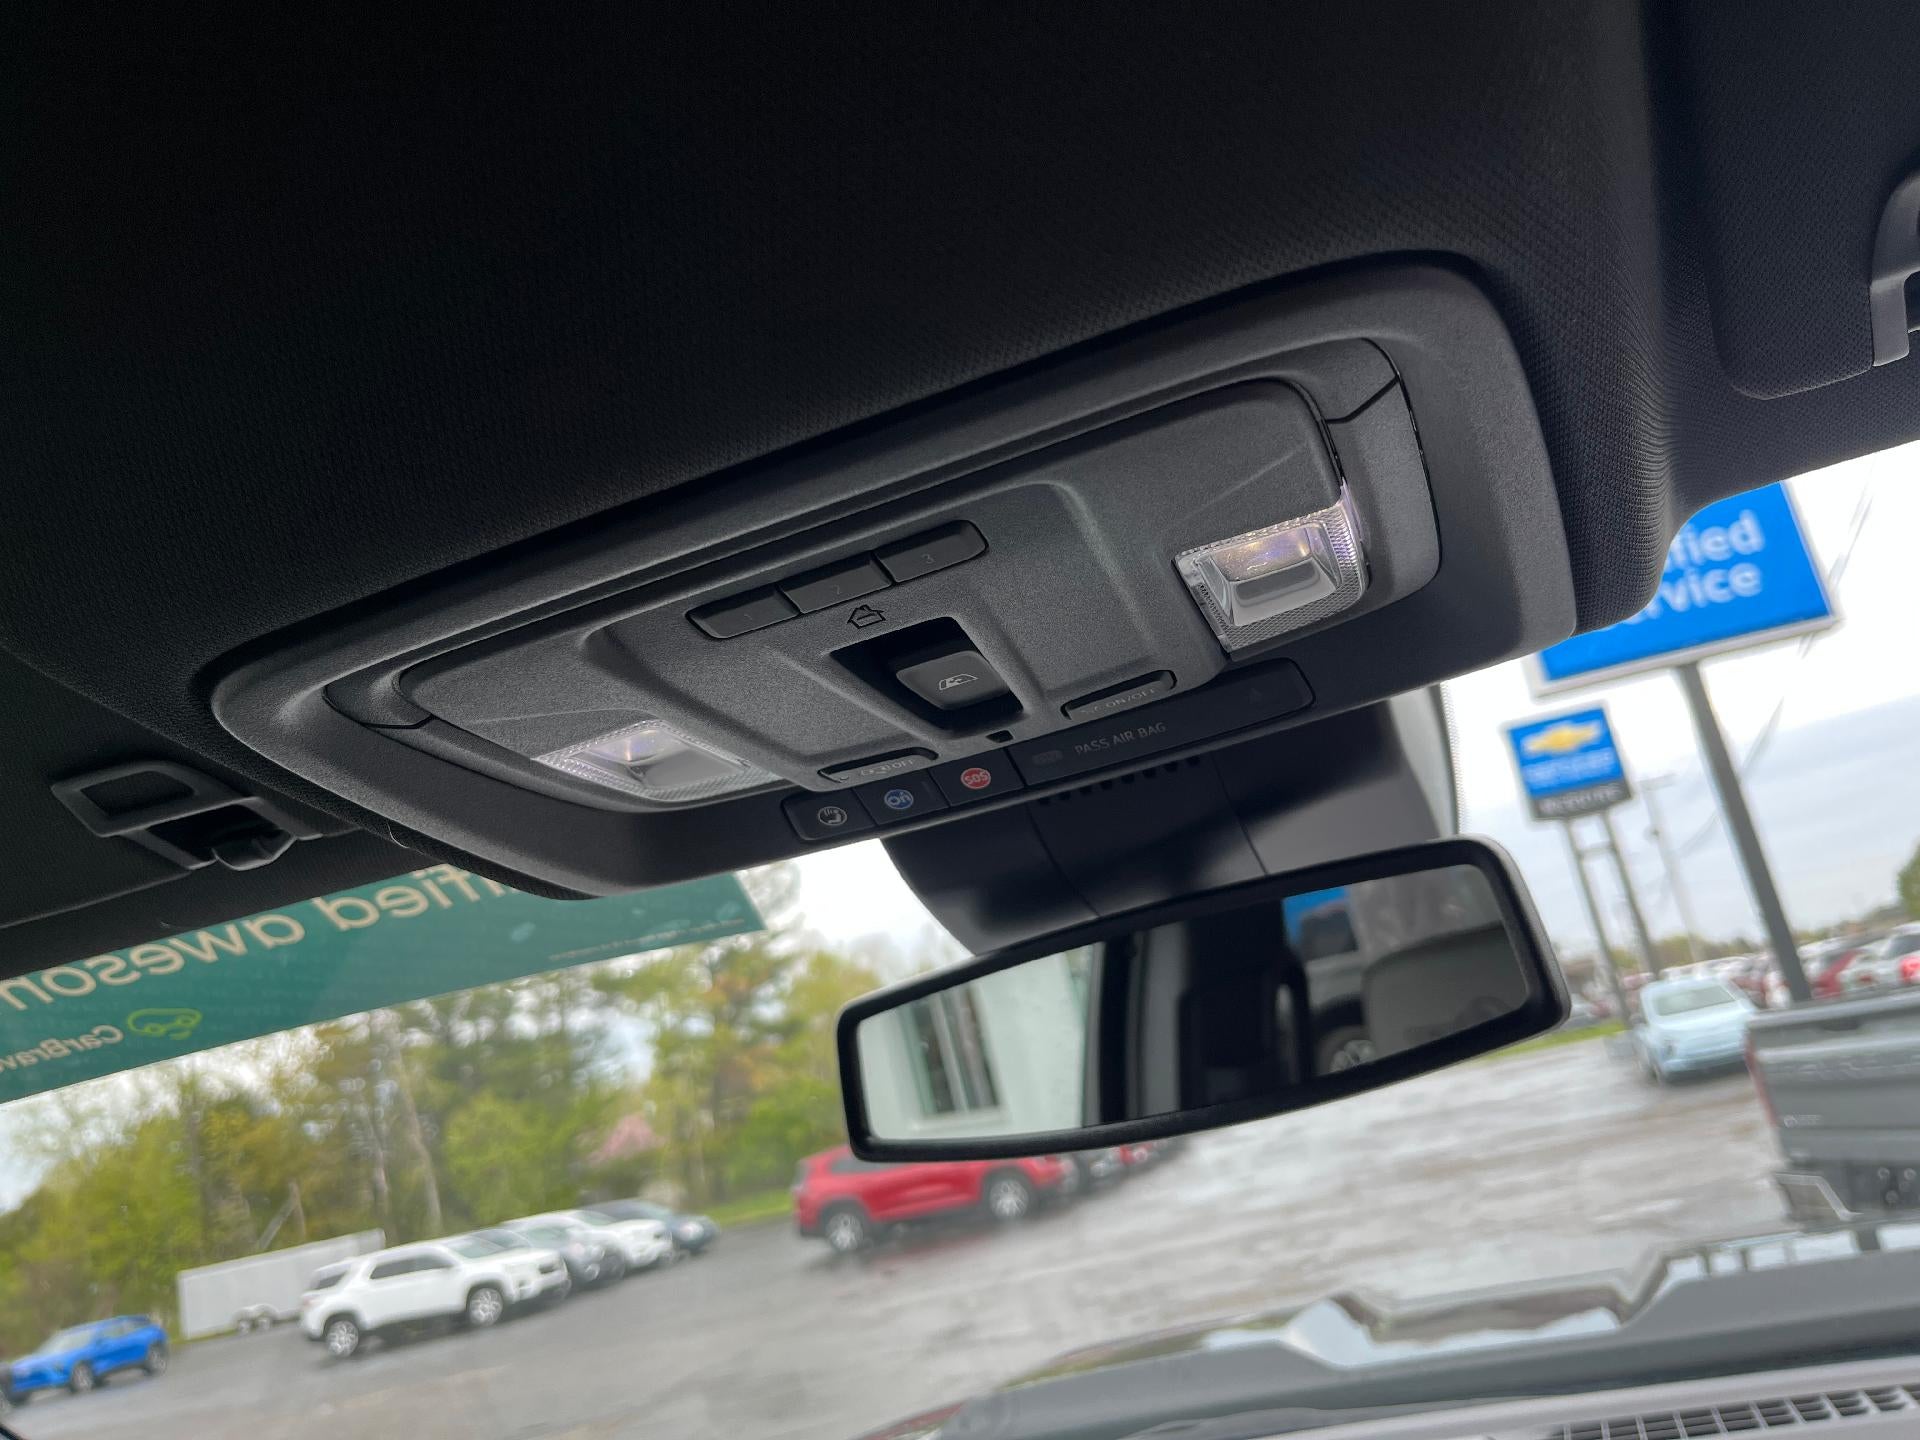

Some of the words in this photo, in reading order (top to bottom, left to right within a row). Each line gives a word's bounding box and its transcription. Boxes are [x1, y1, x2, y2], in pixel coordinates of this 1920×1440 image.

[1074, 737, 1110, 754] PASS
[1113, 730, 1136, 745] AIR
[1139, 722, 1167, 738] BAG
[964, 769, 989, 785] SOS
